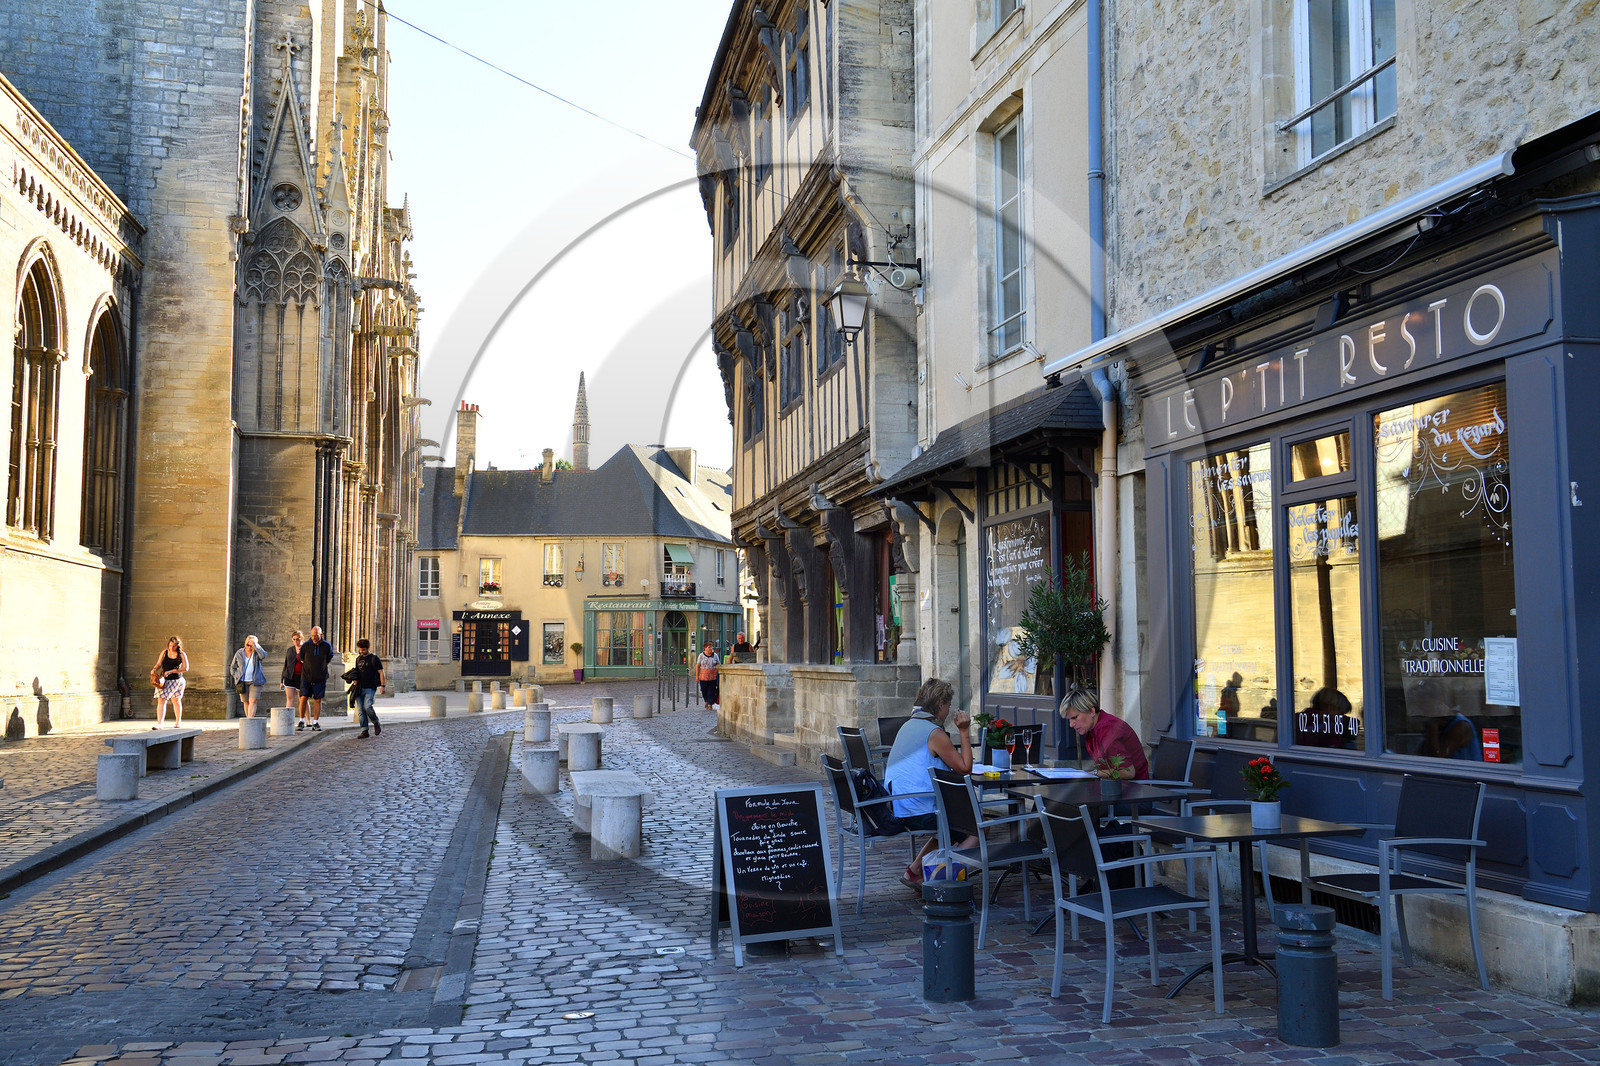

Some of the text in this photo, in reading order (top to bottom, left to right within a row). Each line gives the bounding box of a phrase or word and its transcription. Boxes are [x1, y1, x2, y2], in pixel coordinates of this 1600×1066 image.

[1167, 284, 1506, 439] LE P'TIT RESTO
[1377, 408, 1450, 438] savourer
[1429, 407, 1505, 455] du regard
[1193, 455, 1247, 481] pimenter
[1217, 477, 1237, 492] les
[1289, 505, 1336, 528] délecter
[1303, 526, 1318, 545] les
[588, 601, 653, 610] Restaurant
[1422, 637, 1459, 652] CUISINE
[1404, 659, 1485, 673] TRADITIONNELLE
[1299, 713, 1358, 736] 02 31 51 85 40
